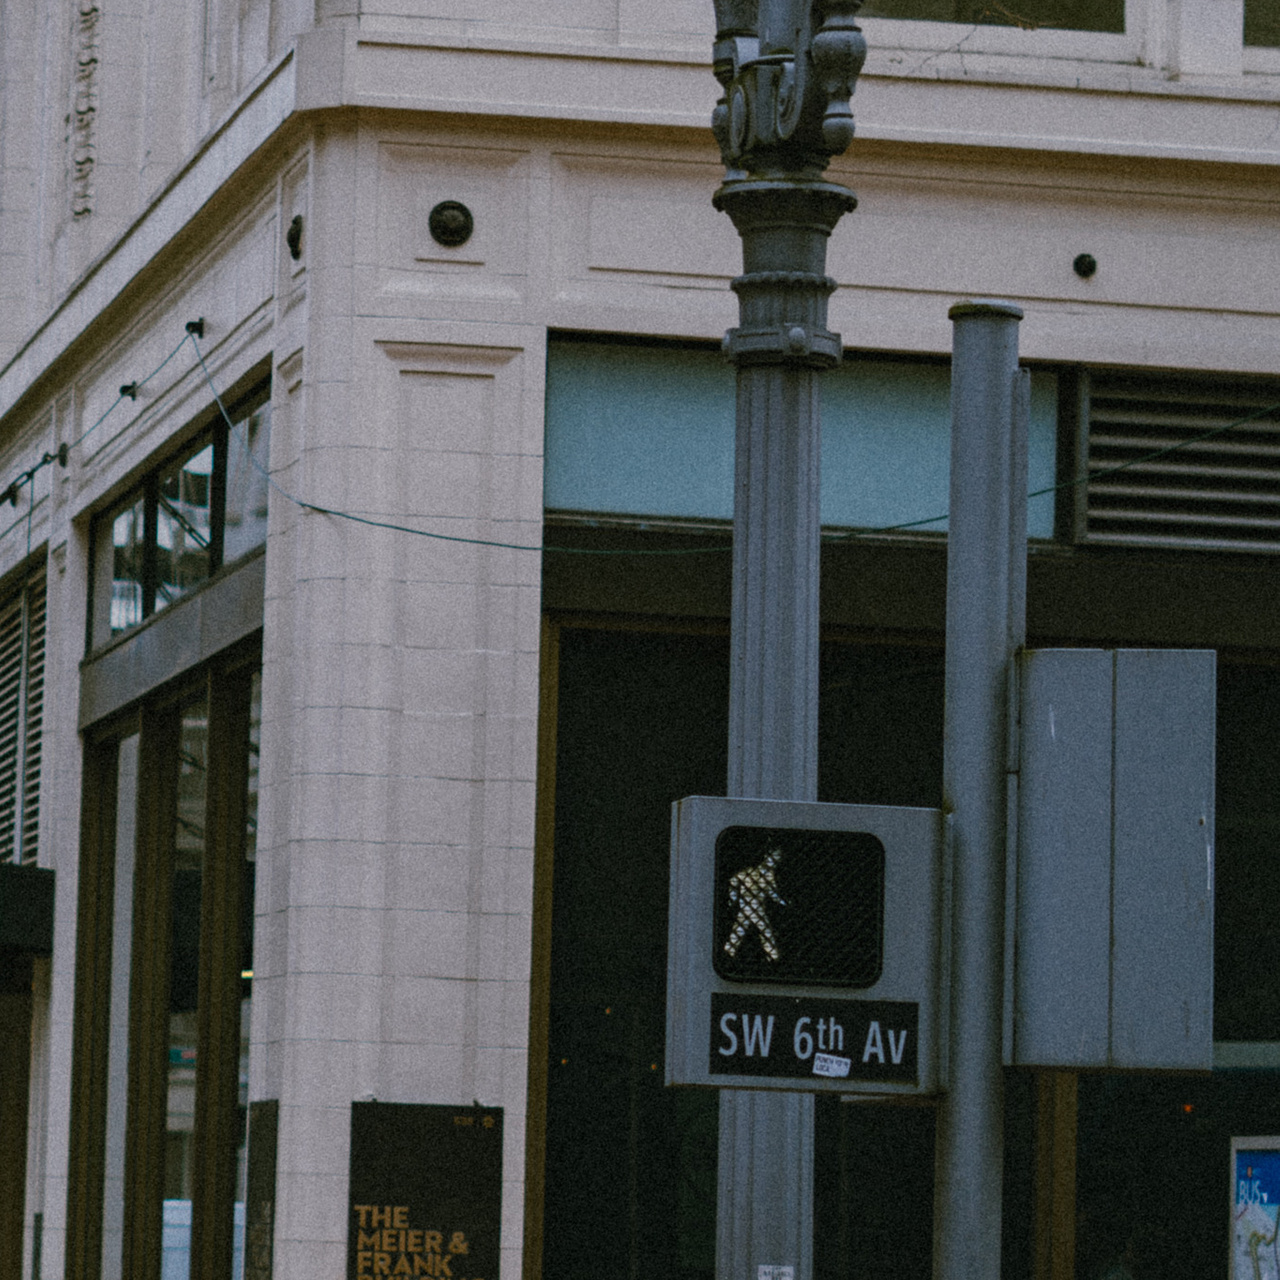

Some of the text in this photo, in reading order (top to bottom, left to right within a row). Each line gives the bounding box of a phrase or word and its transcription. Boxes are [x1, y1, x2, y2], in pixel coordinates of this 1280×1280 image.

[719, 1012, 908, 1065] SW 6th Av
[1240, 1180, 1261, 1206] BUS
[354, 1205, 410, 1229] THE
[357, 1229, 470, 1255] MEIER &
[357, 1251, 453, 1277] FRANK
